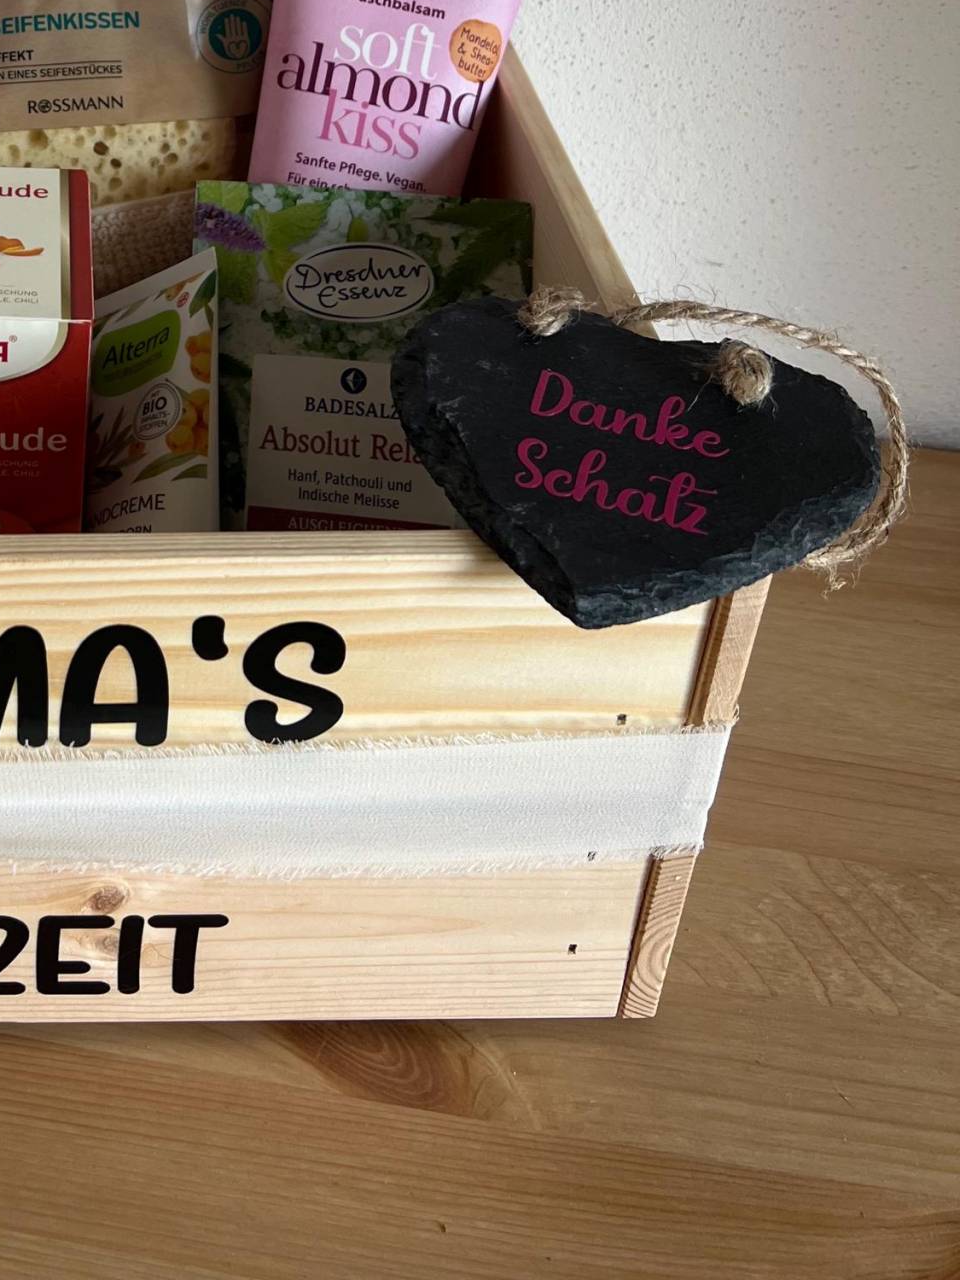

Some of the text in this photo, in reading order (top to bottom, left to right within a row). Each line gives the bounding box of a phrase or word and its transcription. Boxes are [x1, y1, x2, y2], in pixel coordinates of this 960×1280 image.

[333, 22, 440, 81] soft
[7, 69, 38, 80] EINES
[39, 63, 123, 77] SEIFENSTÜCKES
[276, 41, 484, 131] almond
[27, 95, 124, 114] ROSSMANN
[318, 88, 422, 160] kiss
[287, 171, 306, 186] Für
[295, 152, 427, 192] Sanfte Pflege. Vegan.
[295, 257, 426, 291] Dresdner
[317, 285, 408, 309] Essenz
[102, 326, 170, 370] Alterra
[142, 396, 167, 417] BIO
[529, 368, 731, 459] Danke
[259, 424, 425, 465] Absolut Rela
[288, 469, 413, 493] Hanf, Patchouli und
[514, 436, 719, 536] Schatz
[90, 493, 166, 526] NDCREME
[298, 487, 400, 510] Indische Melisse
